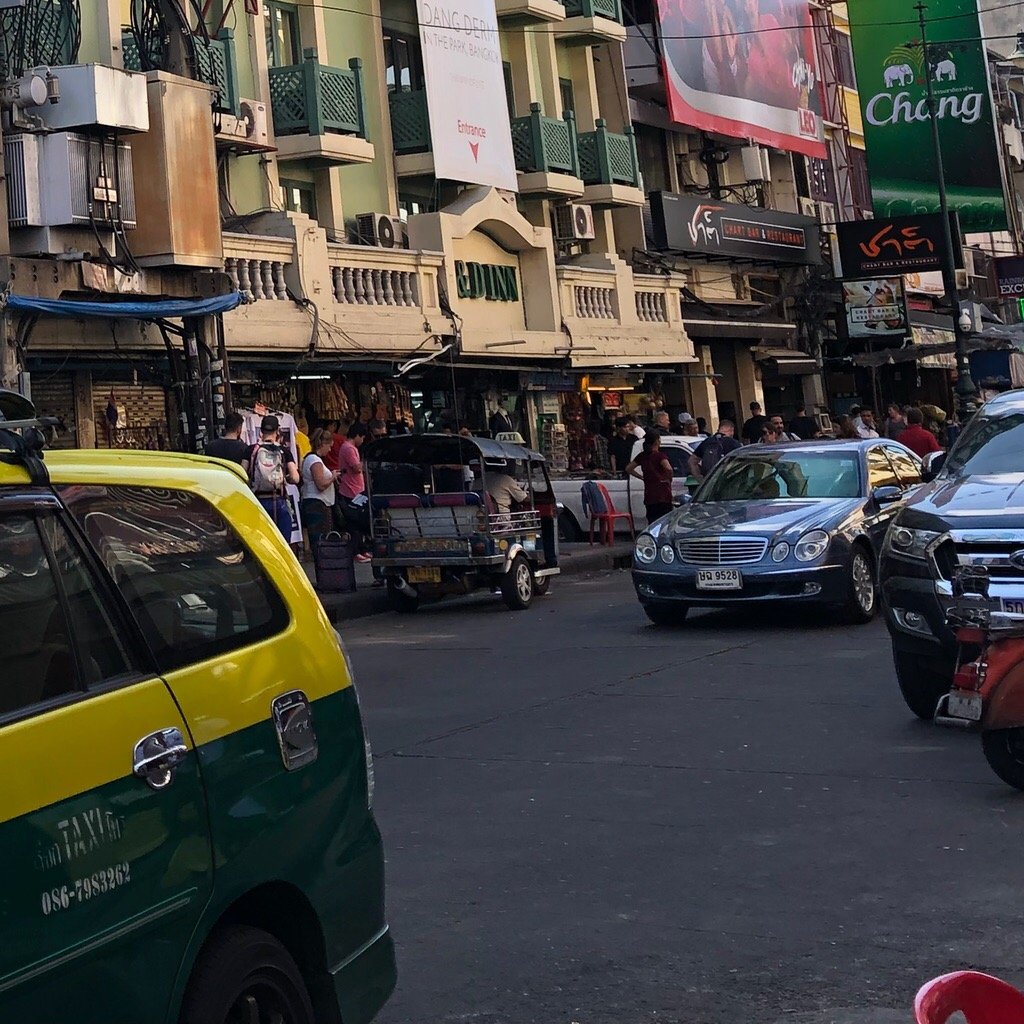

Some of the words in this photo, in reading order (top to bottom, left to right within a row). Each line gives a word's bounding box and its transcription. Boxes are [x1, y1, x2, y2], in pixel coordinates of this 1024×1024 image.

[463, 13, 497, 46] DERM
[865, 91, 983, 126] Chang
[457, 119, 487, 139] Entrance
[1000, 283, 1024, 295] EXC
[715, 570, 738, 580] 9528
